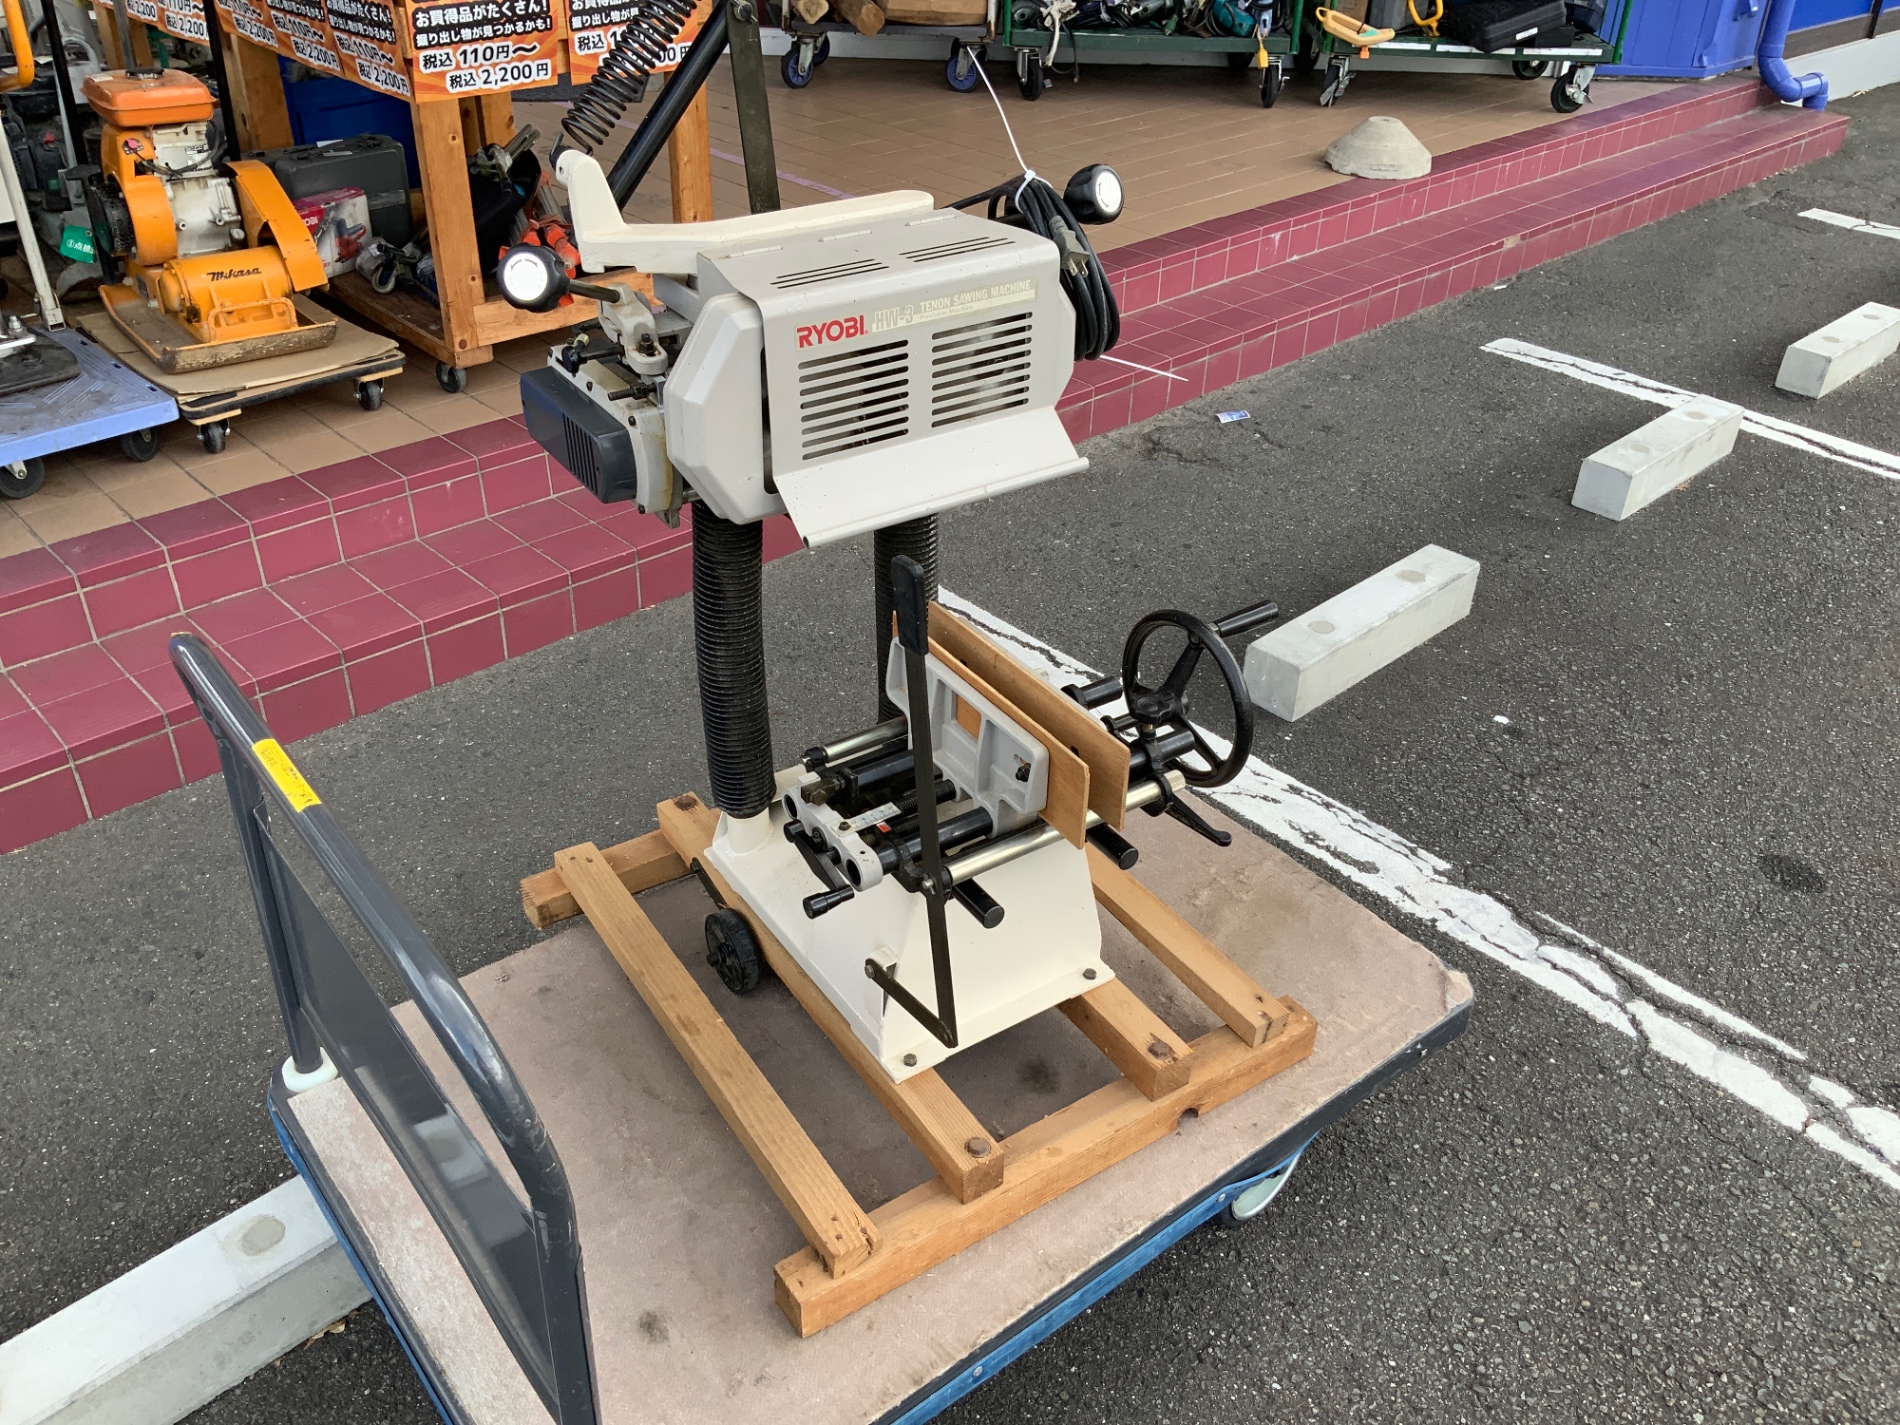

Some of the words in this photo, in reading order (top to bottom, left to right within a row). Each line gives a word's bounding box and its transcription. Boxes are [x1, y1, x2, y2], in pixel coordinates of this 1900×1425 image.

[415, 0, 548, 28] お買得品がたくさん!
[416, 18, 551, 48] 掘り出し物が見つかるかも!
[207, 267, 262, 281] Mikasa
[919, 296, 951, 313] TENON
[953, 289, 988, 306] SAWING
[990, 279, 1031, 299] MACHINE
[796, 314, 866, 349] RYOBI
[874, 304, 914, 331] HW-3
